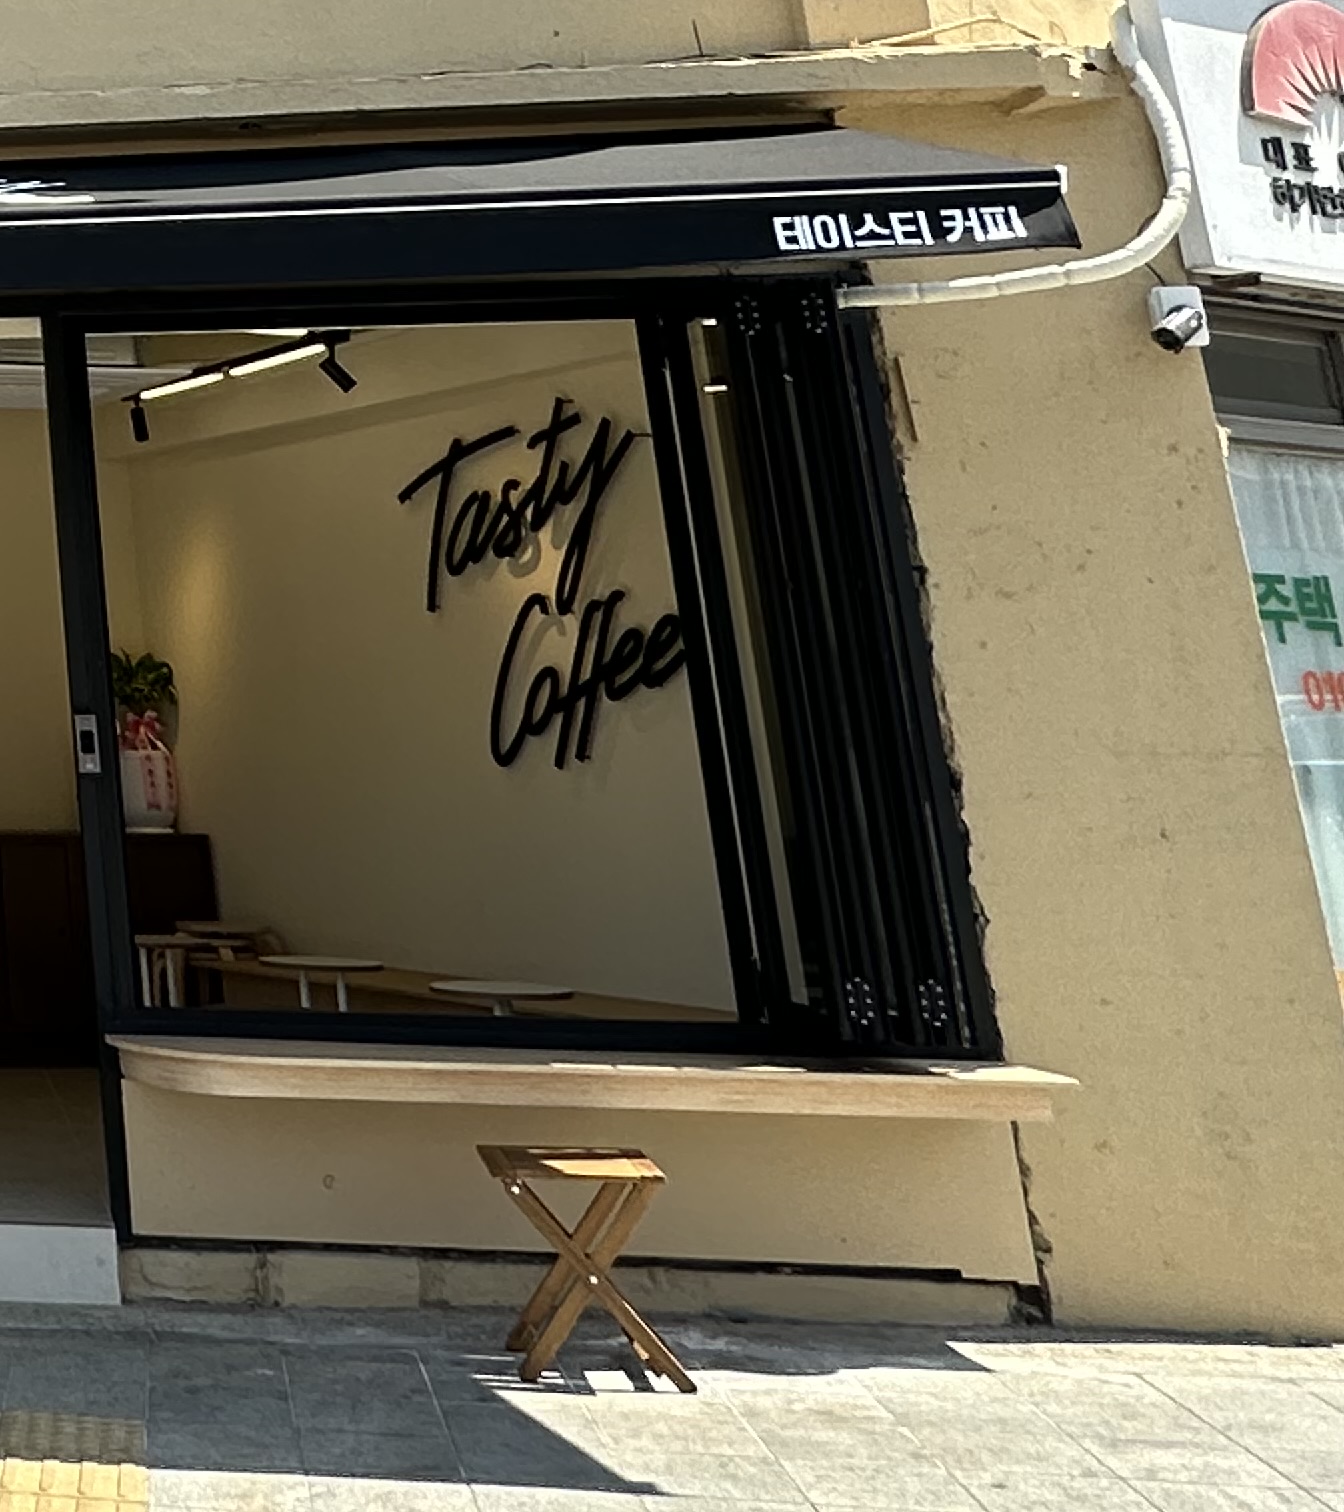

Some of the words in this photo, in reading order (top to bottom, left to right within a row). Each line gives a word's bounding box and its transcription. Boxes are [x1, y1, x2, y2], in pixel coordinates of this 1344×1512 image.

[772, 210, 935, 250] 테이스티
[939, 205, 1028, 243] 커피
[398, 397, 640, 616] Tasty
[490, 591, 687, 769] Coffee
